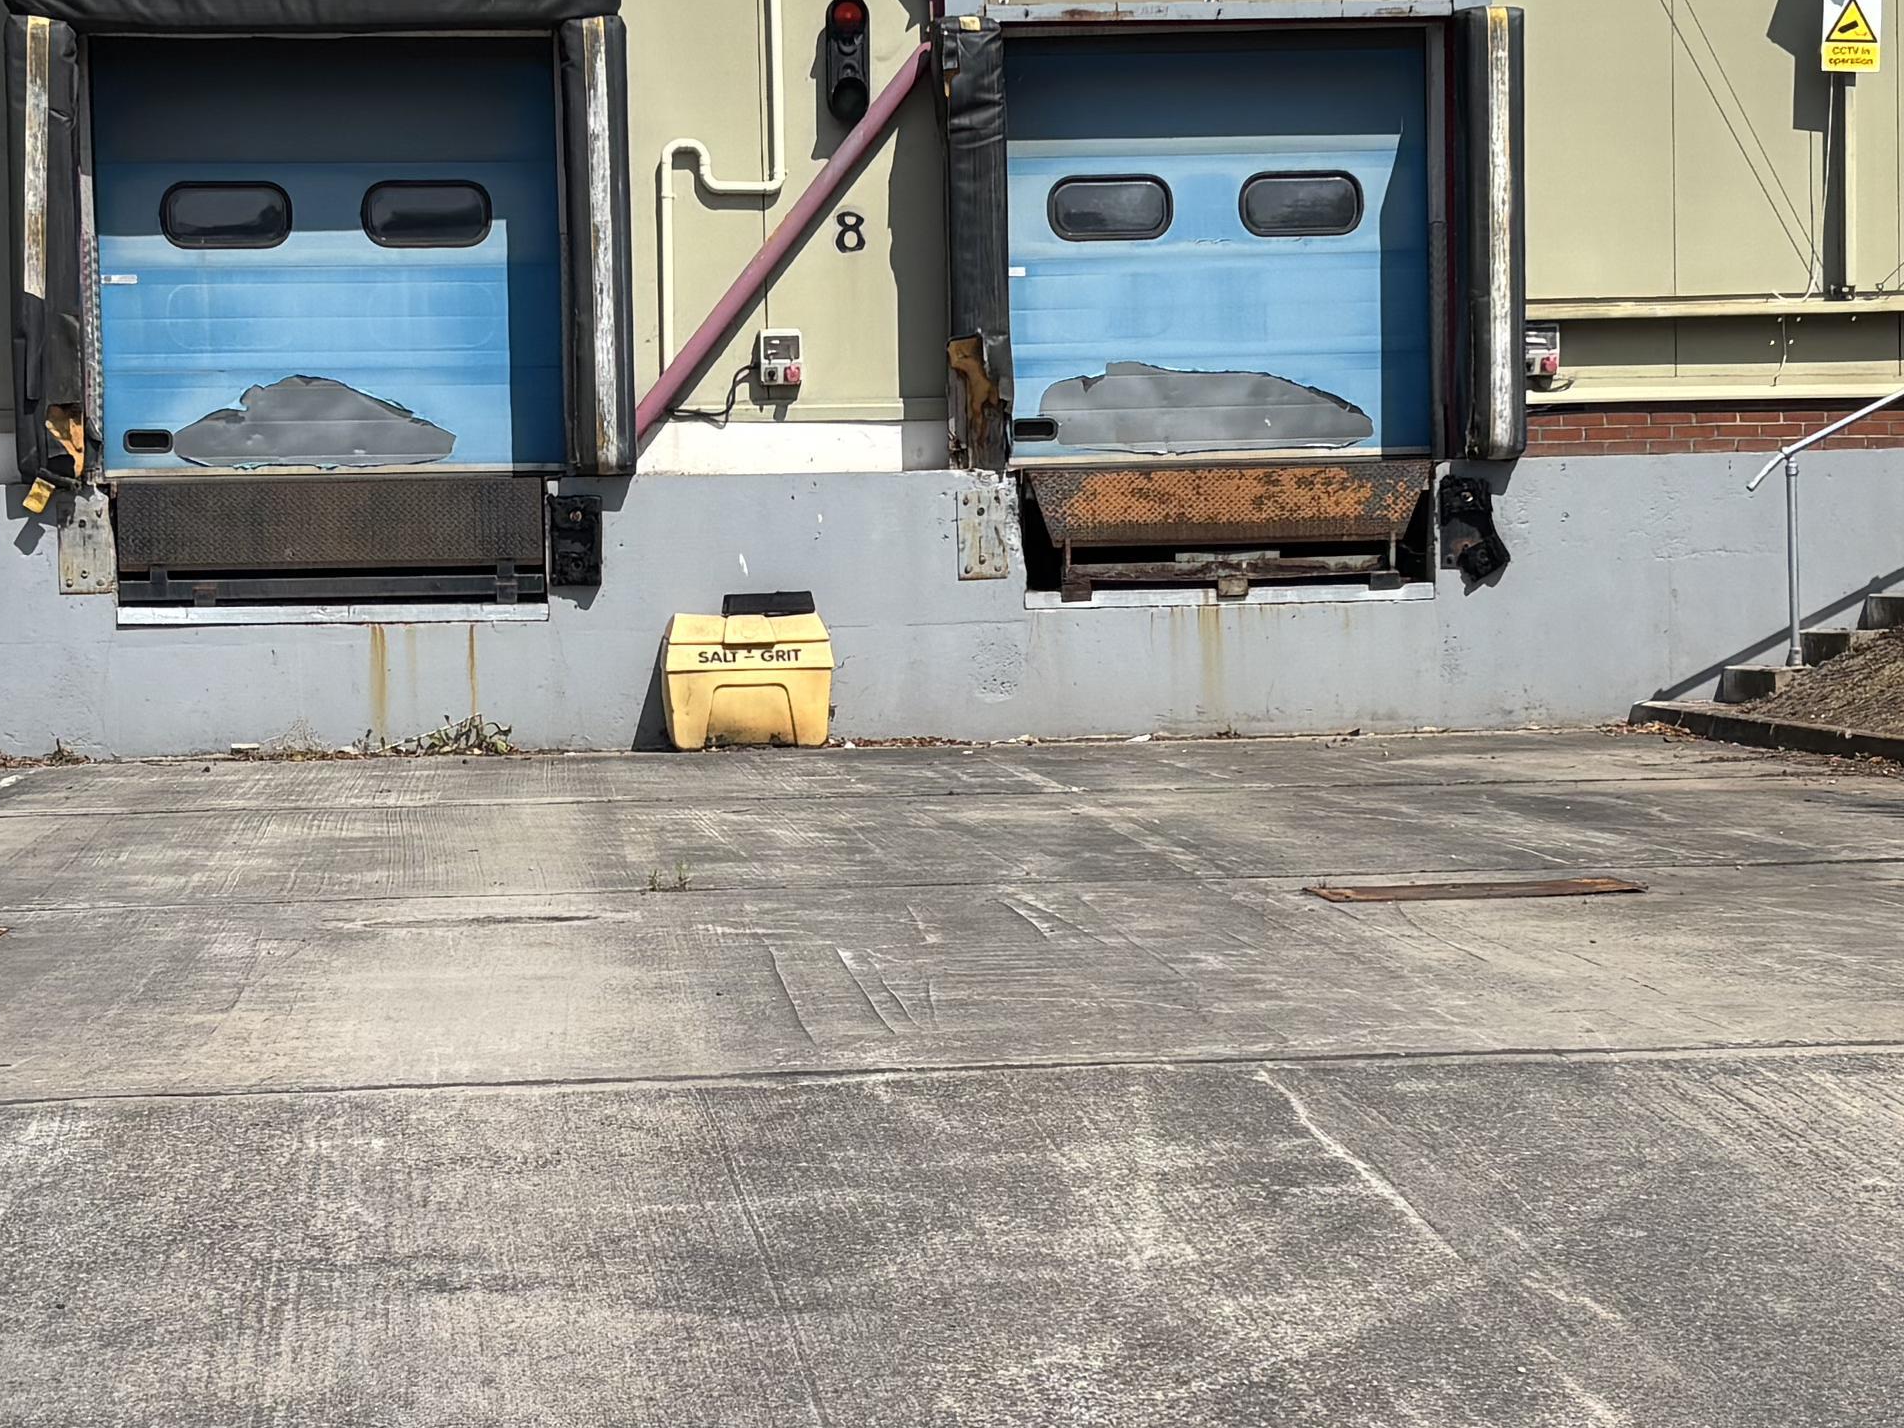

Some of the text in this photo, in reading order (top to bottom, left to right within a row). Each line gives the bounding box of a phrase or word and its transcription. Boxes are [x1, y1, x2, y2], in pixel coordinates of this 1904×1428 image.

[1832, 46, 1859, 55] CCTV
[1828, 57, 1874, 66] operation
[835, 211, 866, 254] 8
[698, 651, 738, 664] SALT
[760, 649, 802, 662] GRIT
